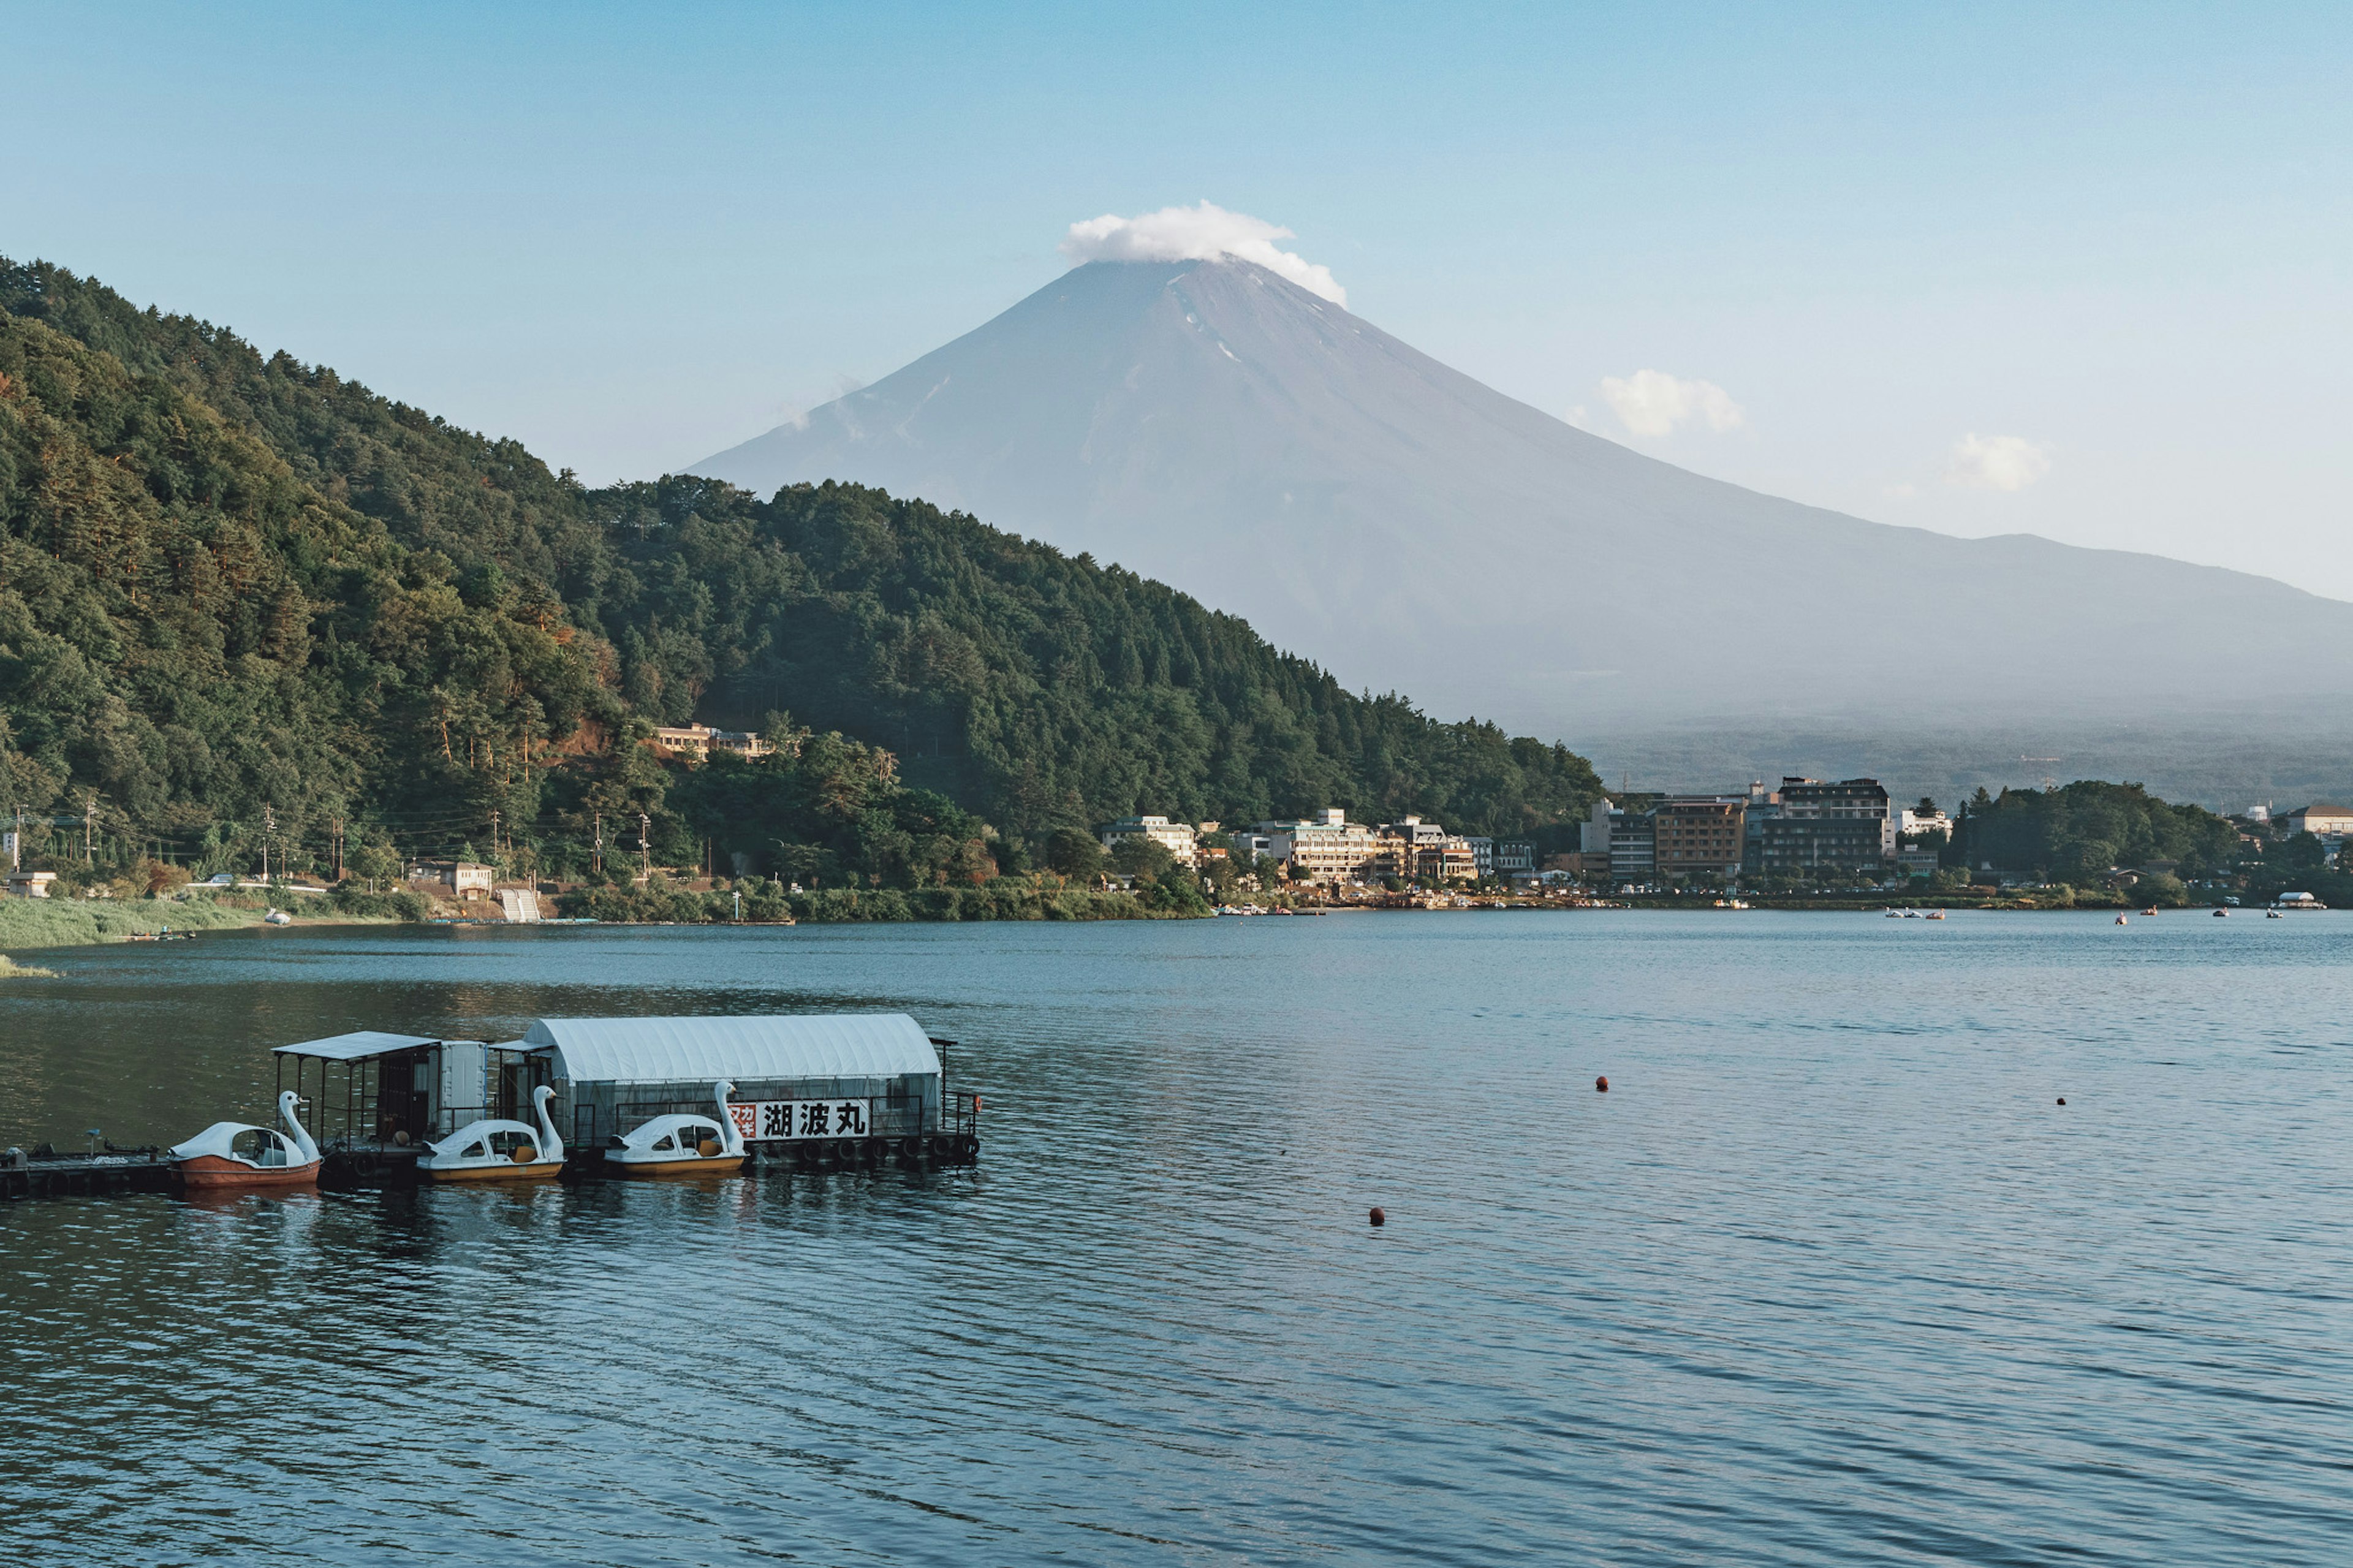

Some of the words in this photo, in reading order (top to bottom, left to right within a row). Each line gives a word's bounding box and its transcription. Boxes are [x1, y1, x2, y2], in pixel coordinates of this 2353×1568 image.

[735, 1121, 754, 1137] ギ
[764, 1102, 865, 1137] 湖波丸
